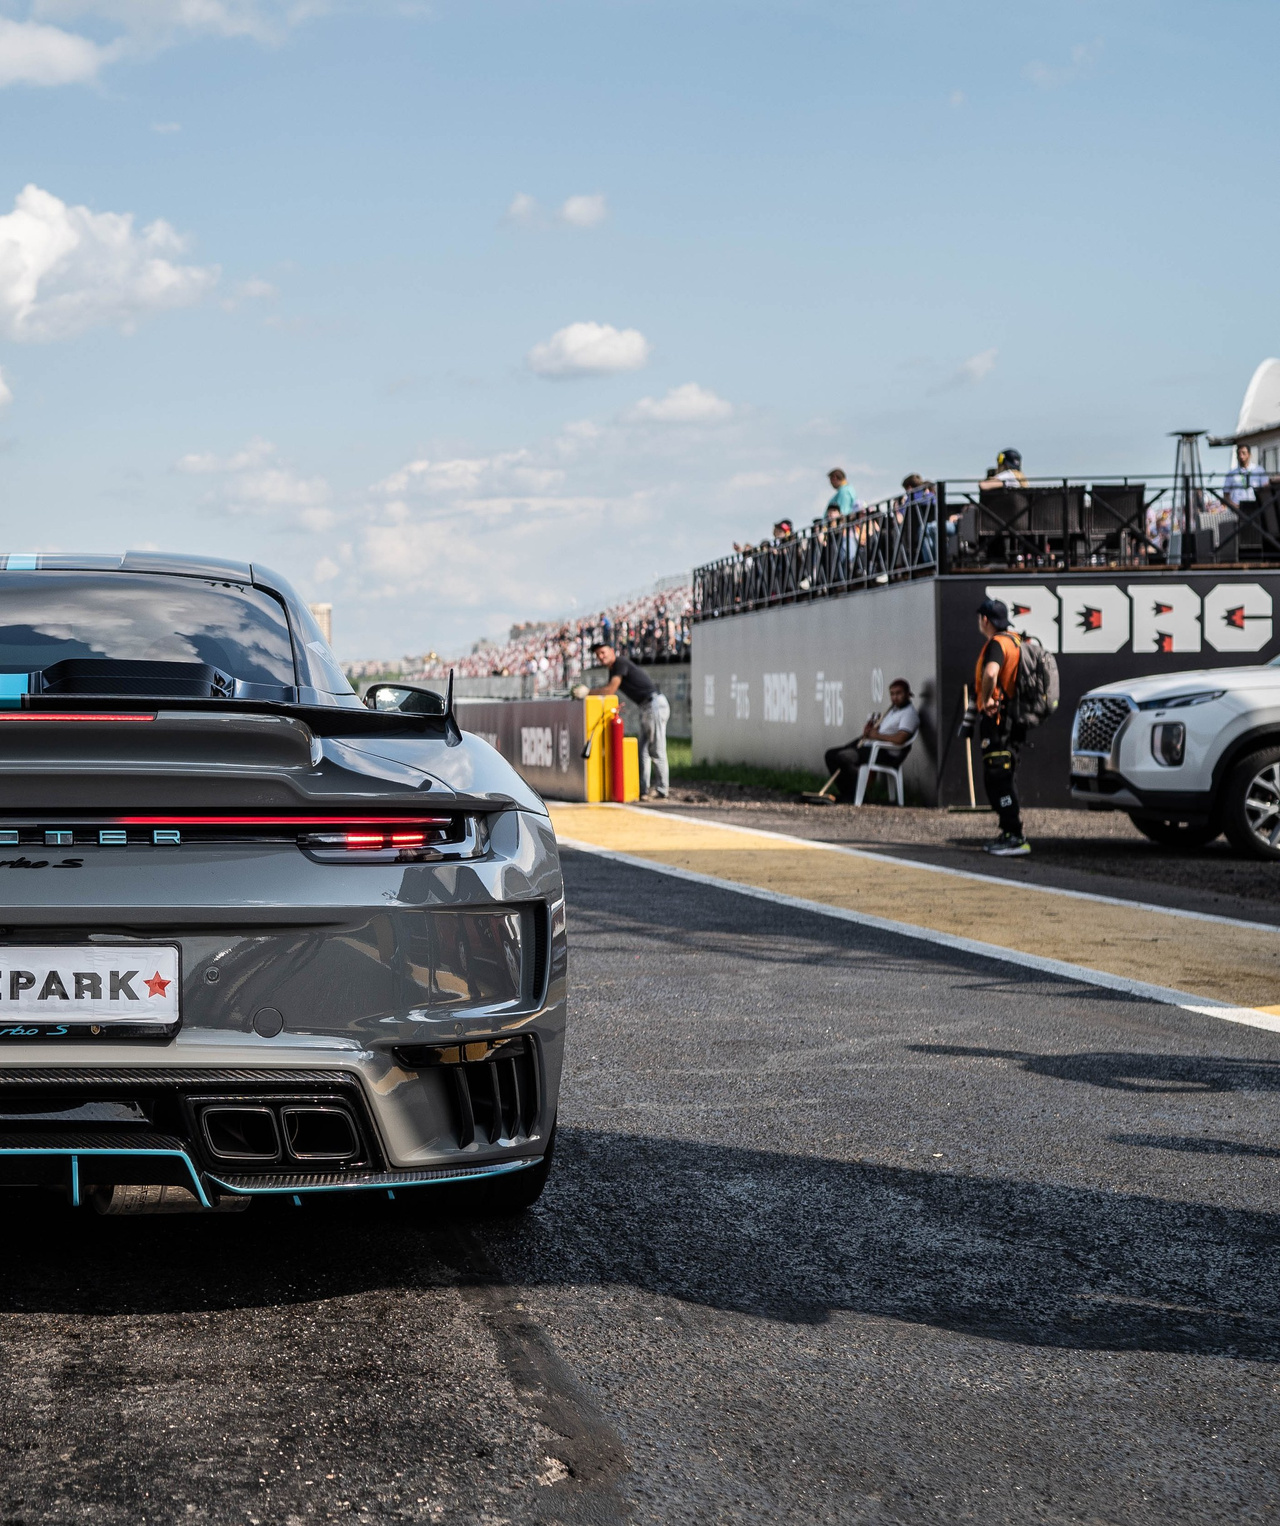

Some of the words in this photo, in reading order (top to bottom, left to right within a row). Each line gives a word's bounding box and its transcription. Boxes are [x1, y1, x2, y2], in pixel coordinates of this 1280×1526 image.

[986, 584, 1272, 653] RDRC
[53, 858, 84, 868] S
[46, 1024, 70, 1036] S
